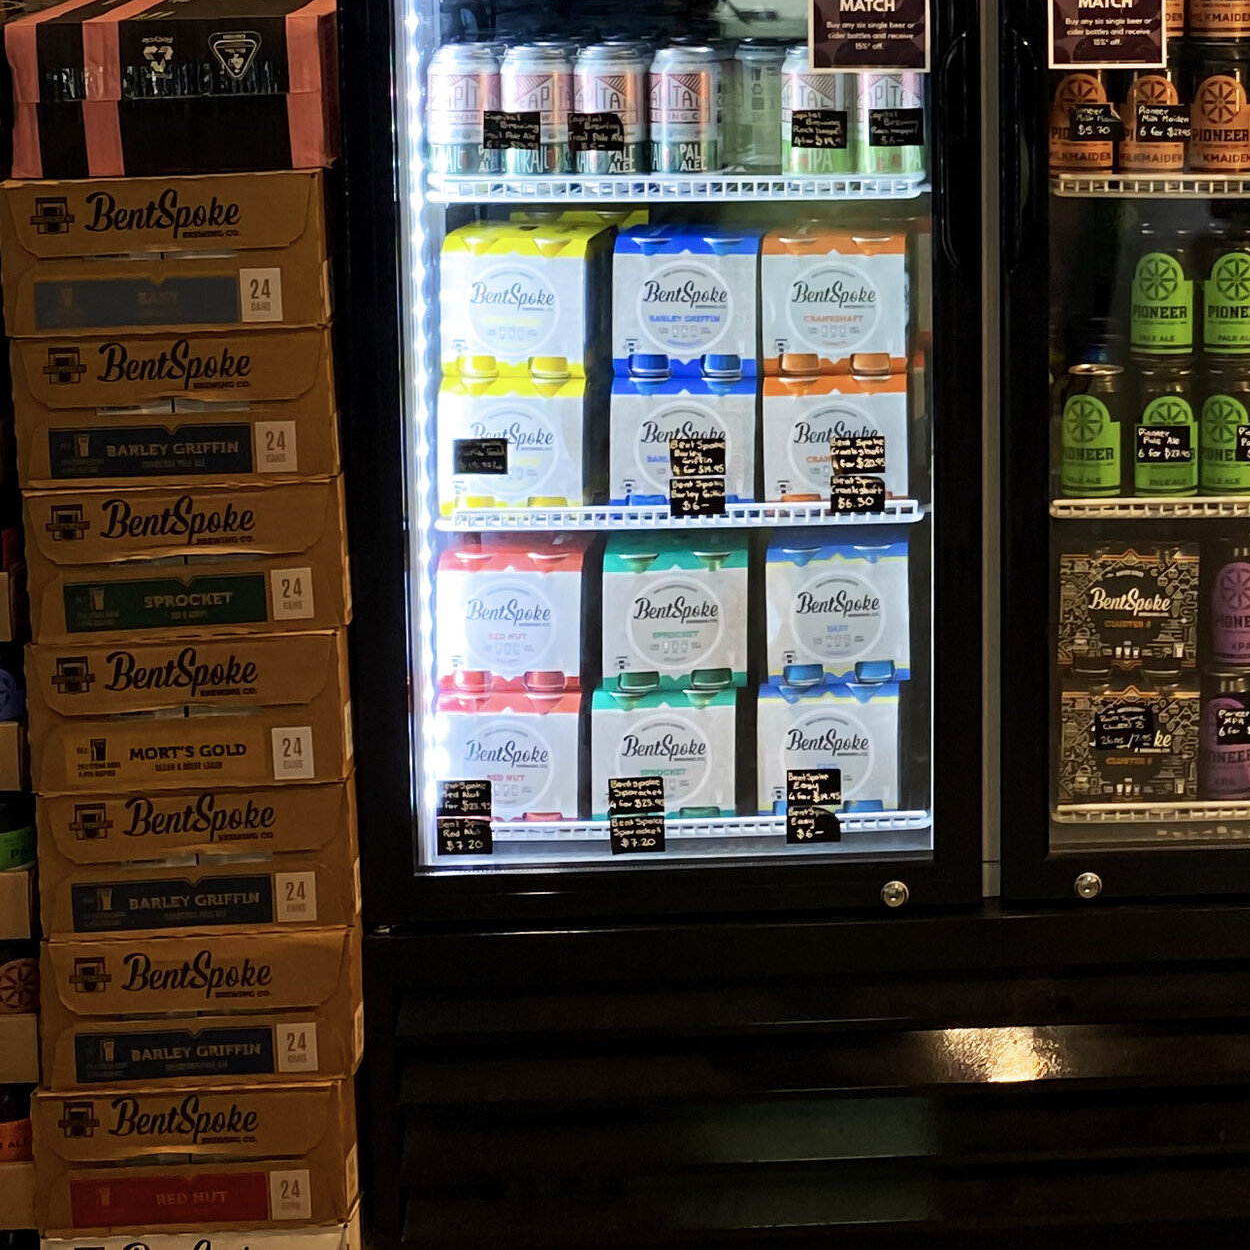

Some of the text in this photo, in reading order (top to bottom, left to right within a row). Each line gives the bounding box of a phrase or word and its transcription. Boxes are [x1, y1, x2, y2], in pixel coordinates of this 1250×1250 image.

[826, 21, 840, 29] Buy
[842, 22, 855, 30] any
[867, 21, 888, 30] single
[1192, 129, 1249, 142] PIONEER
[85, 188, 241, 239] BentSpoke
[250, 278, 271, 299] 24
[470, 279, 555, 310] BentSpoke
[642, 279, 728, 311] BentSpoke
[791, 279, 876, 311] BentSpoke
[804, 315, 863, 323] CRANKSHAFT
[1133, 306, 1187, 319] PIONEER
[97, 339, 251, 390] BentSpoke
[107, 441, 239, 457] BARLEY GRIFFIN
[265, 430, 286, 451] 24
[100, 495, 255, 545] BentSpoke
[281, 578, 303, 599] 24
[144, 592, 234, 609] SPROCKET
[465, 597, 551, 623] BentSpoke
[632, 597, 719, 625] BentSpoke
[794, 589, 880, 620] BentSpoke
[1088, 587, 1171, 617] BentSpoke
[104, 647, 258, 697] BentSpoke
[129, 743, 247, 761] MORT'S GOLD
[282, 737, 303, 758] 24
[465, 739, 549, 766] BentSpoke
[621, 734, 707, 764] BentSpoke
[786, 728, 869, 757] BentSpoke
[123, 793, 276, 843] BentSpoke
[129, 892, 259, 911] BARLEY GRIFFIN
[285, 881, 306, 901] 24
[121, 950, 272, 999] BentSpoke
[131, 1043, 262, 1062] BARLEY GRIFFIN
[286, 1032, 307, 1052] 24
[108, 1094, 259, 1144] BentSpoke
[156, 1190, 228, 1206] RED NUT
[280, 1180, 301, 1200] 24
